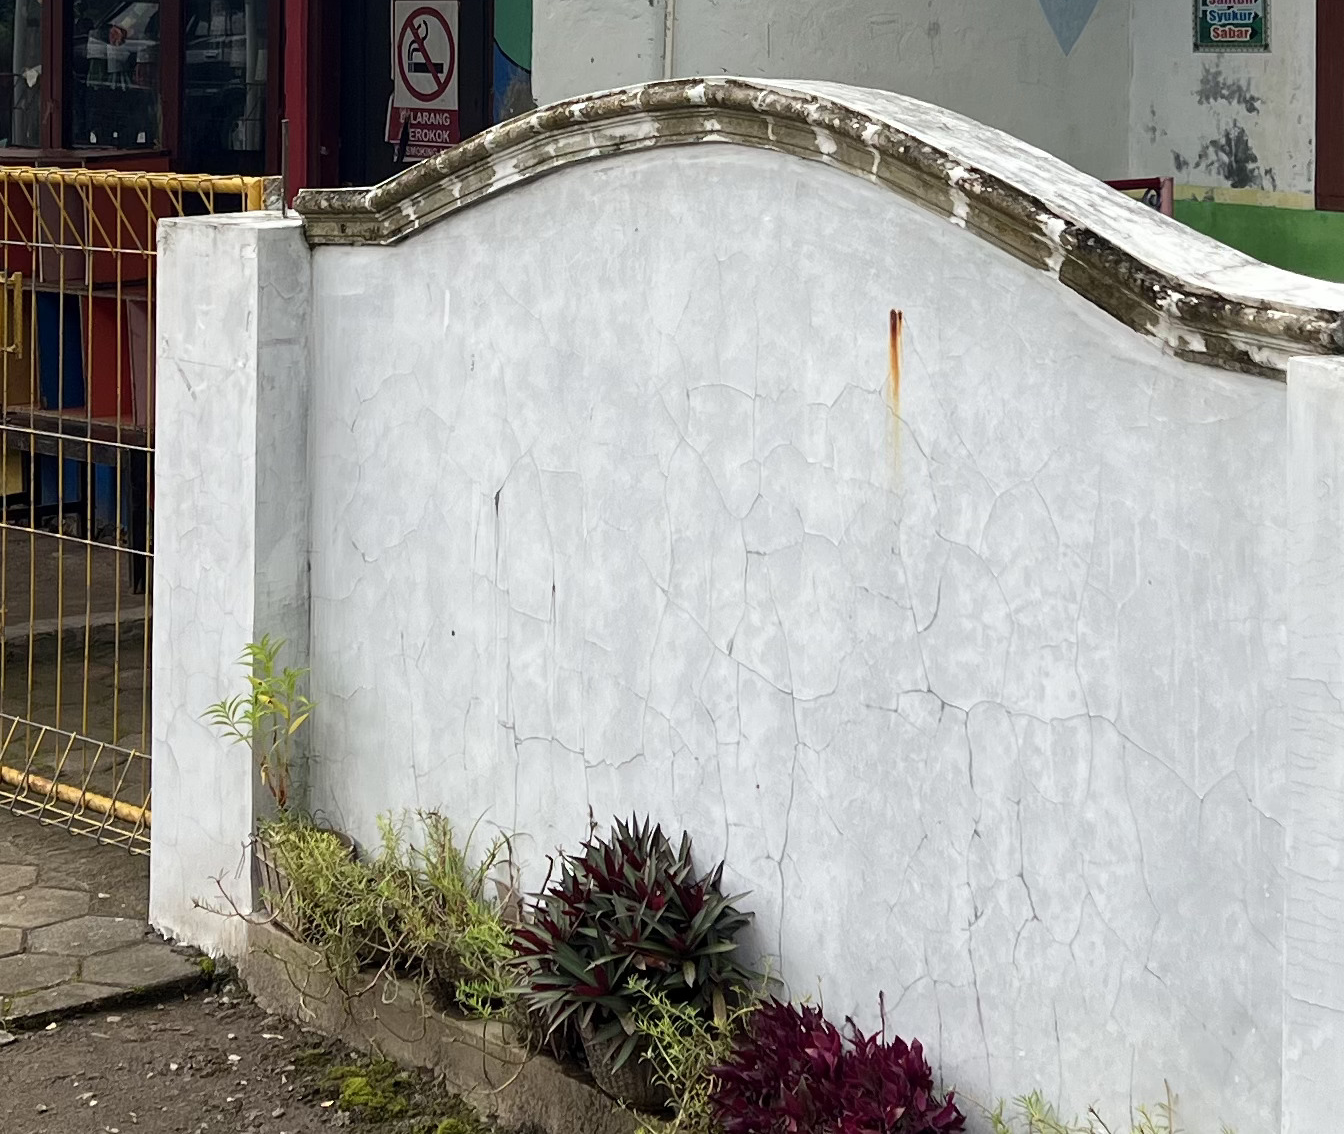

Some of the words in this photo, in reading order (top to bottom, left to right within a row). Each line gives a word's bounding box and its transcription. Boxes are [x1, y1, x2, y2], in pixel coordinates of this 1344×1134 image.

[1208, 9, 1253, 23] Syukur
[1212, 27, 1250, 40] Sabar
[408, 128, 450, 143] EROKOK
